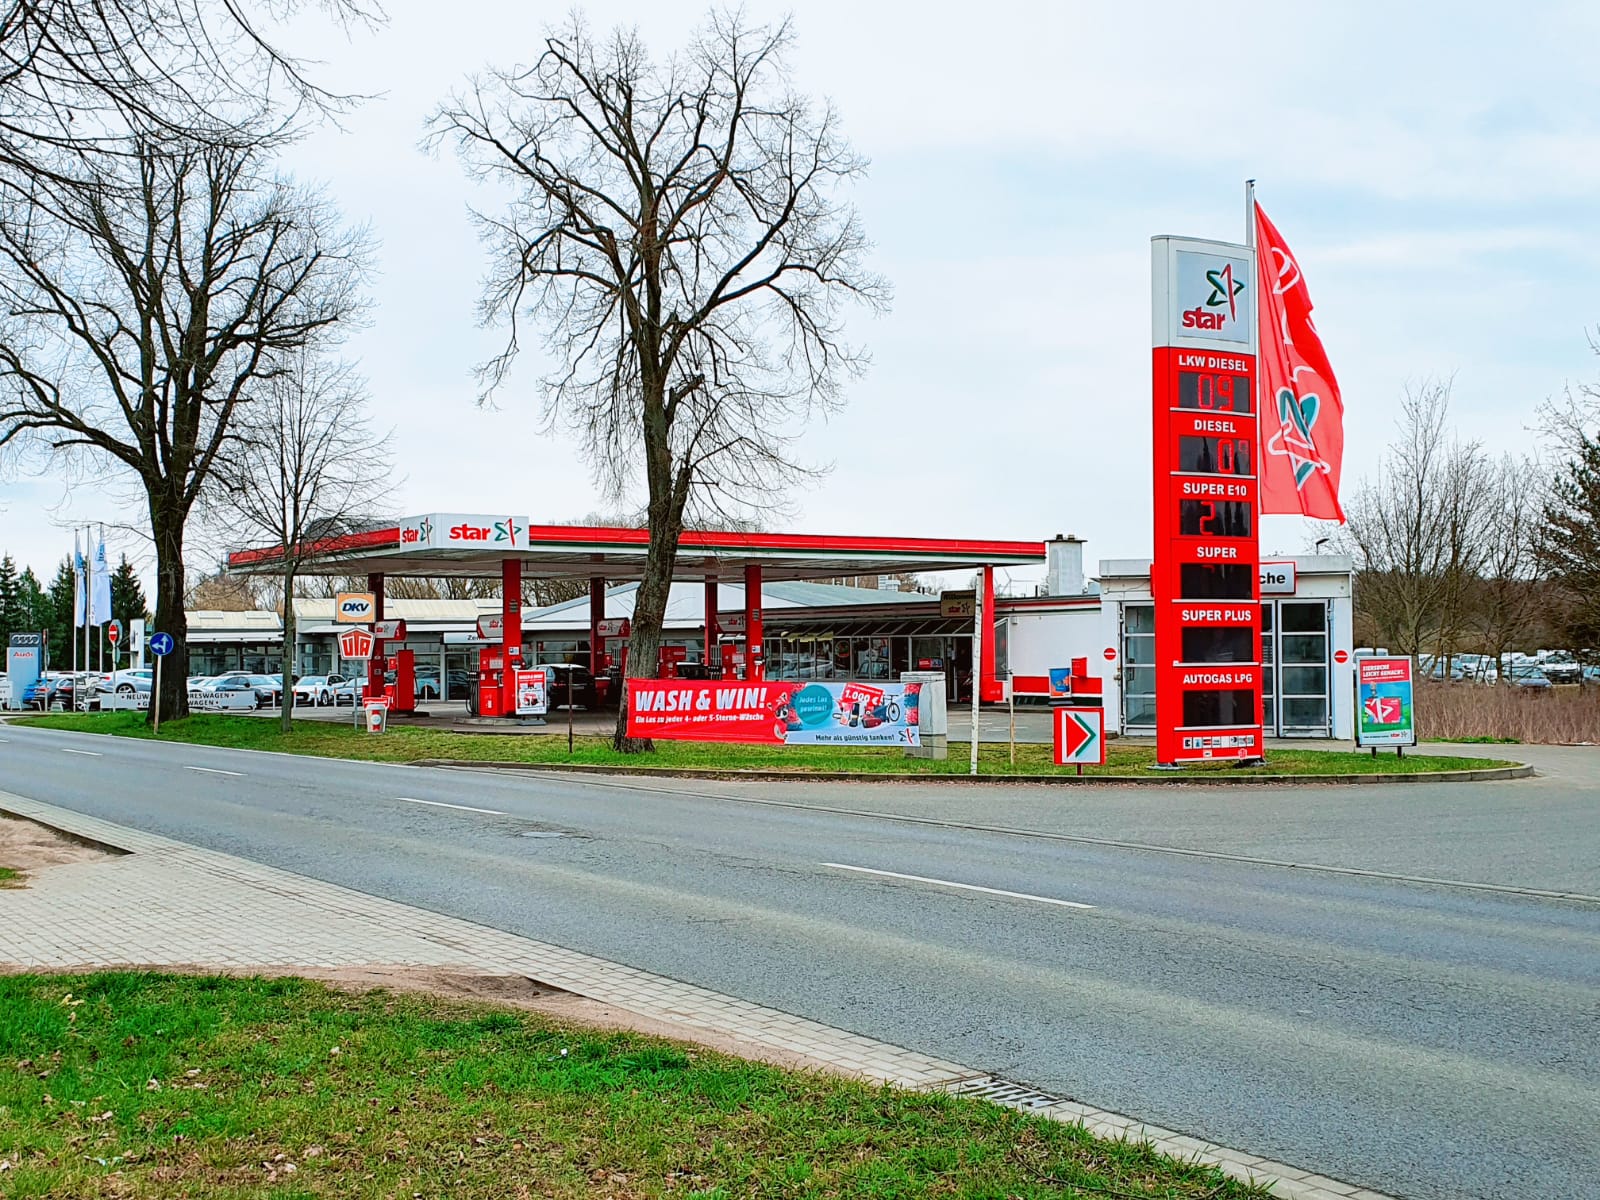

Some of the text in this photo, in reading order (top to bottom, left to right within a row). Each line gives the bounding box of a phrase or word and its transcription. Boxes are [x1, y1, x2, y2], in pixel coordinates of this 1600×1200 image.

[1182, 306, 1226, 330] star
[1178, 355, 1249, 371] LKW DIESEL
[1194, 419, 1236, 433] DIESEL
[1183, 483, 1247, 496] SUPER E10
[402, 526, 419, 543] star
[449, 523, 491, 541] star
[1197, 546, 1237, 558] SUPER
[342, 602, 370, 612] DKV
[1182, 609, 1252, 621] SUPER PLUS
[342, 629, 371, 657] UTA
[1183, 673, 1253, 684] AUTOGAS LPG
[635, 687, 767, 712] WASH & WIN!
[845, 690, 870, 703] 1.000
[844, 734, 868, 742] günstig
